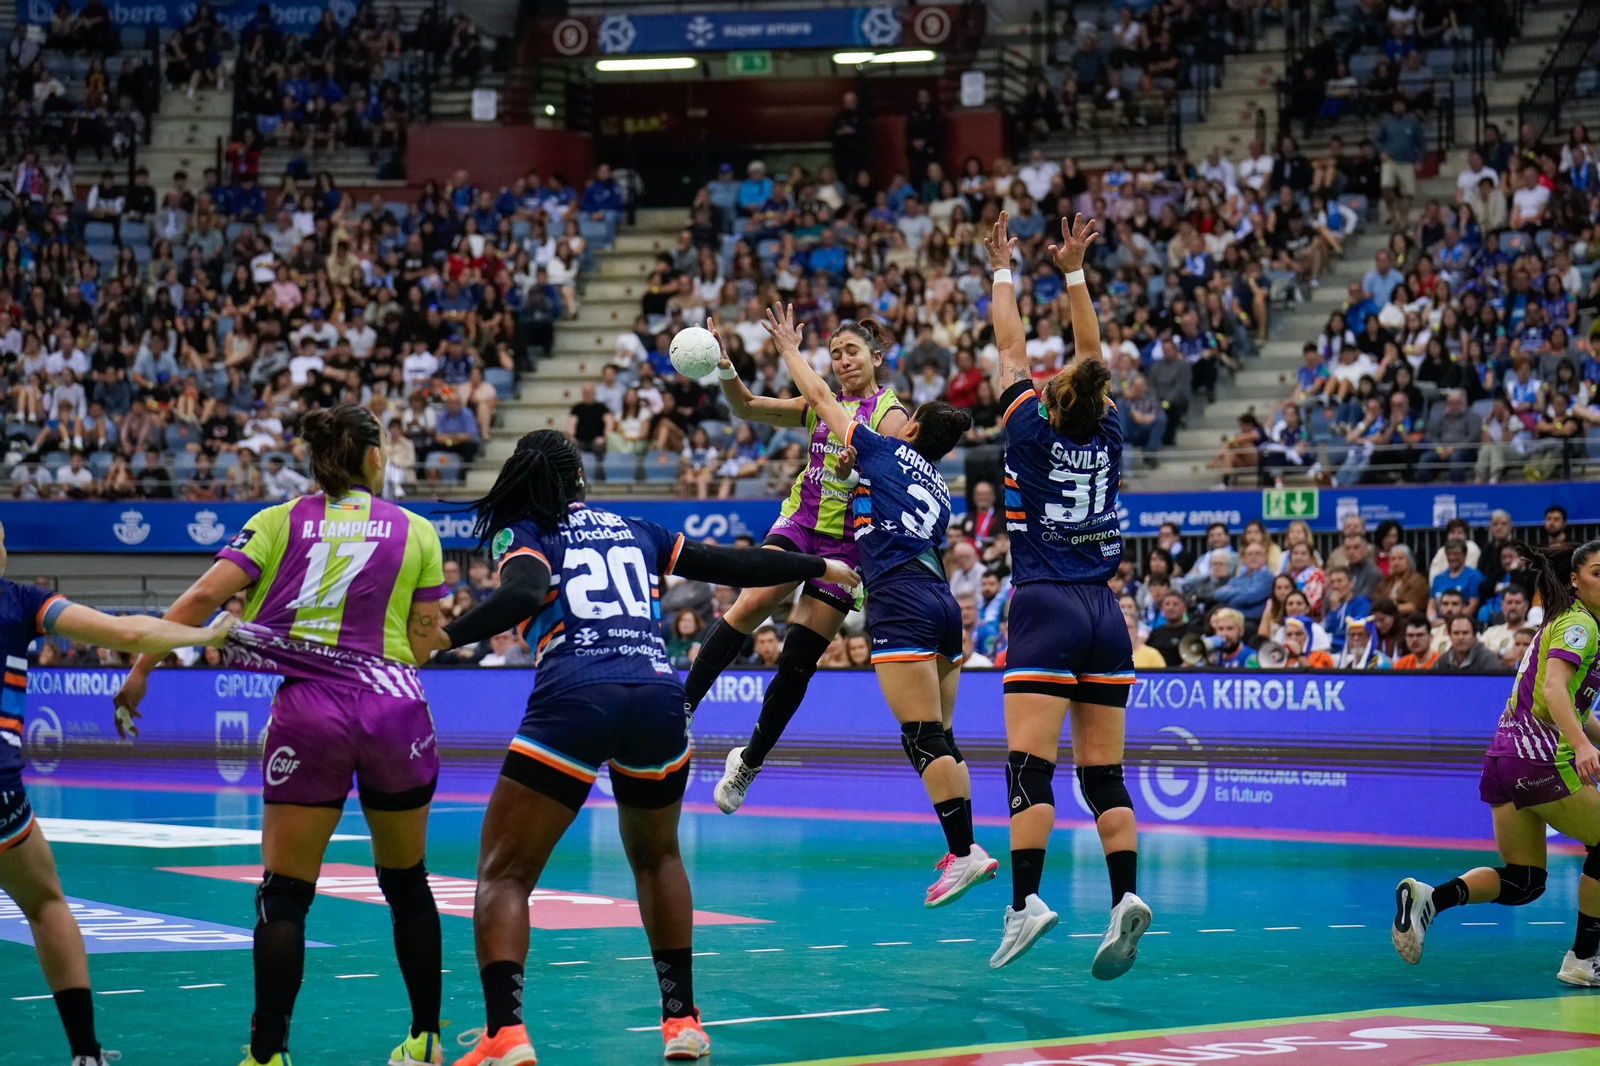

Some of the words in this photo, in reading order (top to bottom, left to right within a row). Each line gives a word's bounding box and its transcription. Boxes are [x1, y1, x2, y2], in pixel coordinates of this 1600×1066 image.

[1044, 469, 1109, 522] 31
[901, 483, 941, 540] 3
[1139, 511, 1187, 526] super
[1188, 510, 1241, 525] amara
[574, 527, 635, 543] Occident
[1071, 529, 1121, 545] GIPUZKOA
[1102, 548, 1121, 557] VASCO
[285, 541, 380, 609] 17
[562, 545, 651, 620] 20
[608, 628, 640, 639] super
[27, 672, 64, 695] ZKOA
[215, 674, 285, 698] GIPUZKO
[700, 675, 765, 704] IROL
[1213, 679, 1346, 711] KIROLAK
[1214, 786, 1229, 802] Es
[1231, 786, 1273, 803] futuro
